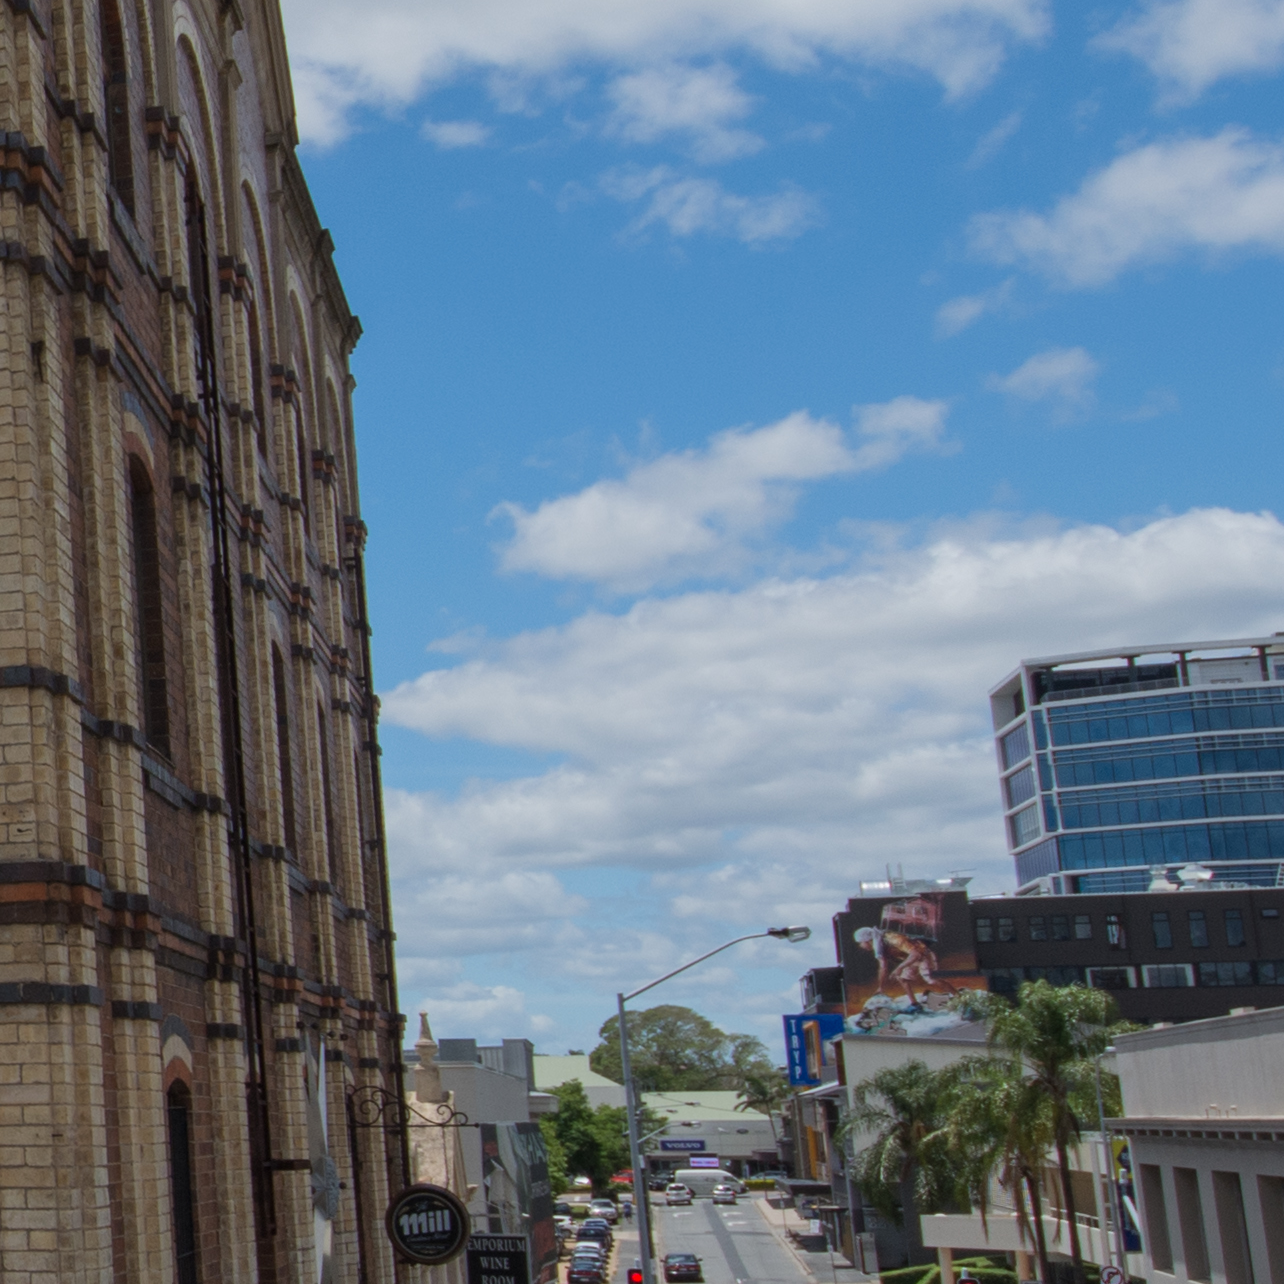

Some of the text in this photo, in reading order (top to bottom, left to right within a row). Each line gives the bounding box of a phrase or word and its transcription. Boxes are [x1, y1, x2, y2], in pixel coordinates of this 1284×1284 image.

[789, 1019, 802, 1080] TRYP
[467, 1237, 526, 1252] EMPORIUM
[479, 1256, 510, 1270] WINE
